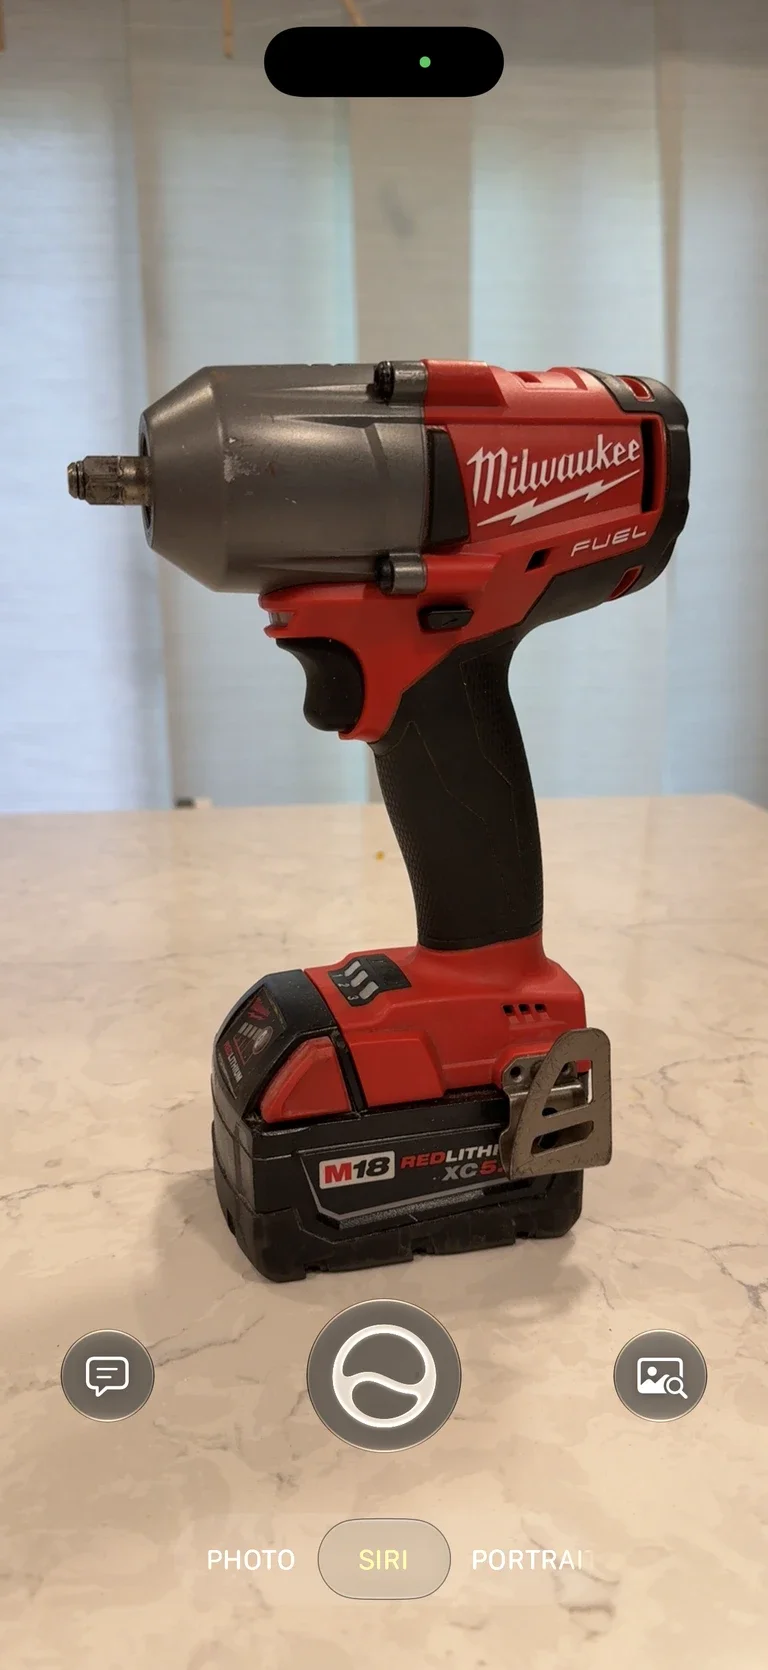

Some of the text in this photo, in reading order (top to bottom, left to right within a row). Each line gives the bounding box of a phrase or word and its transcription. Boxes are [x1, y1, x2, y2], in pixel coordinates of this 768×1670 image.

[466, 433, 641, 507] Milwaukee
[570, 525, 647, 557] FUEL
[324, 1156, 391, 1184] M18
[400, 1143, 499, 1170] REDLITHI
